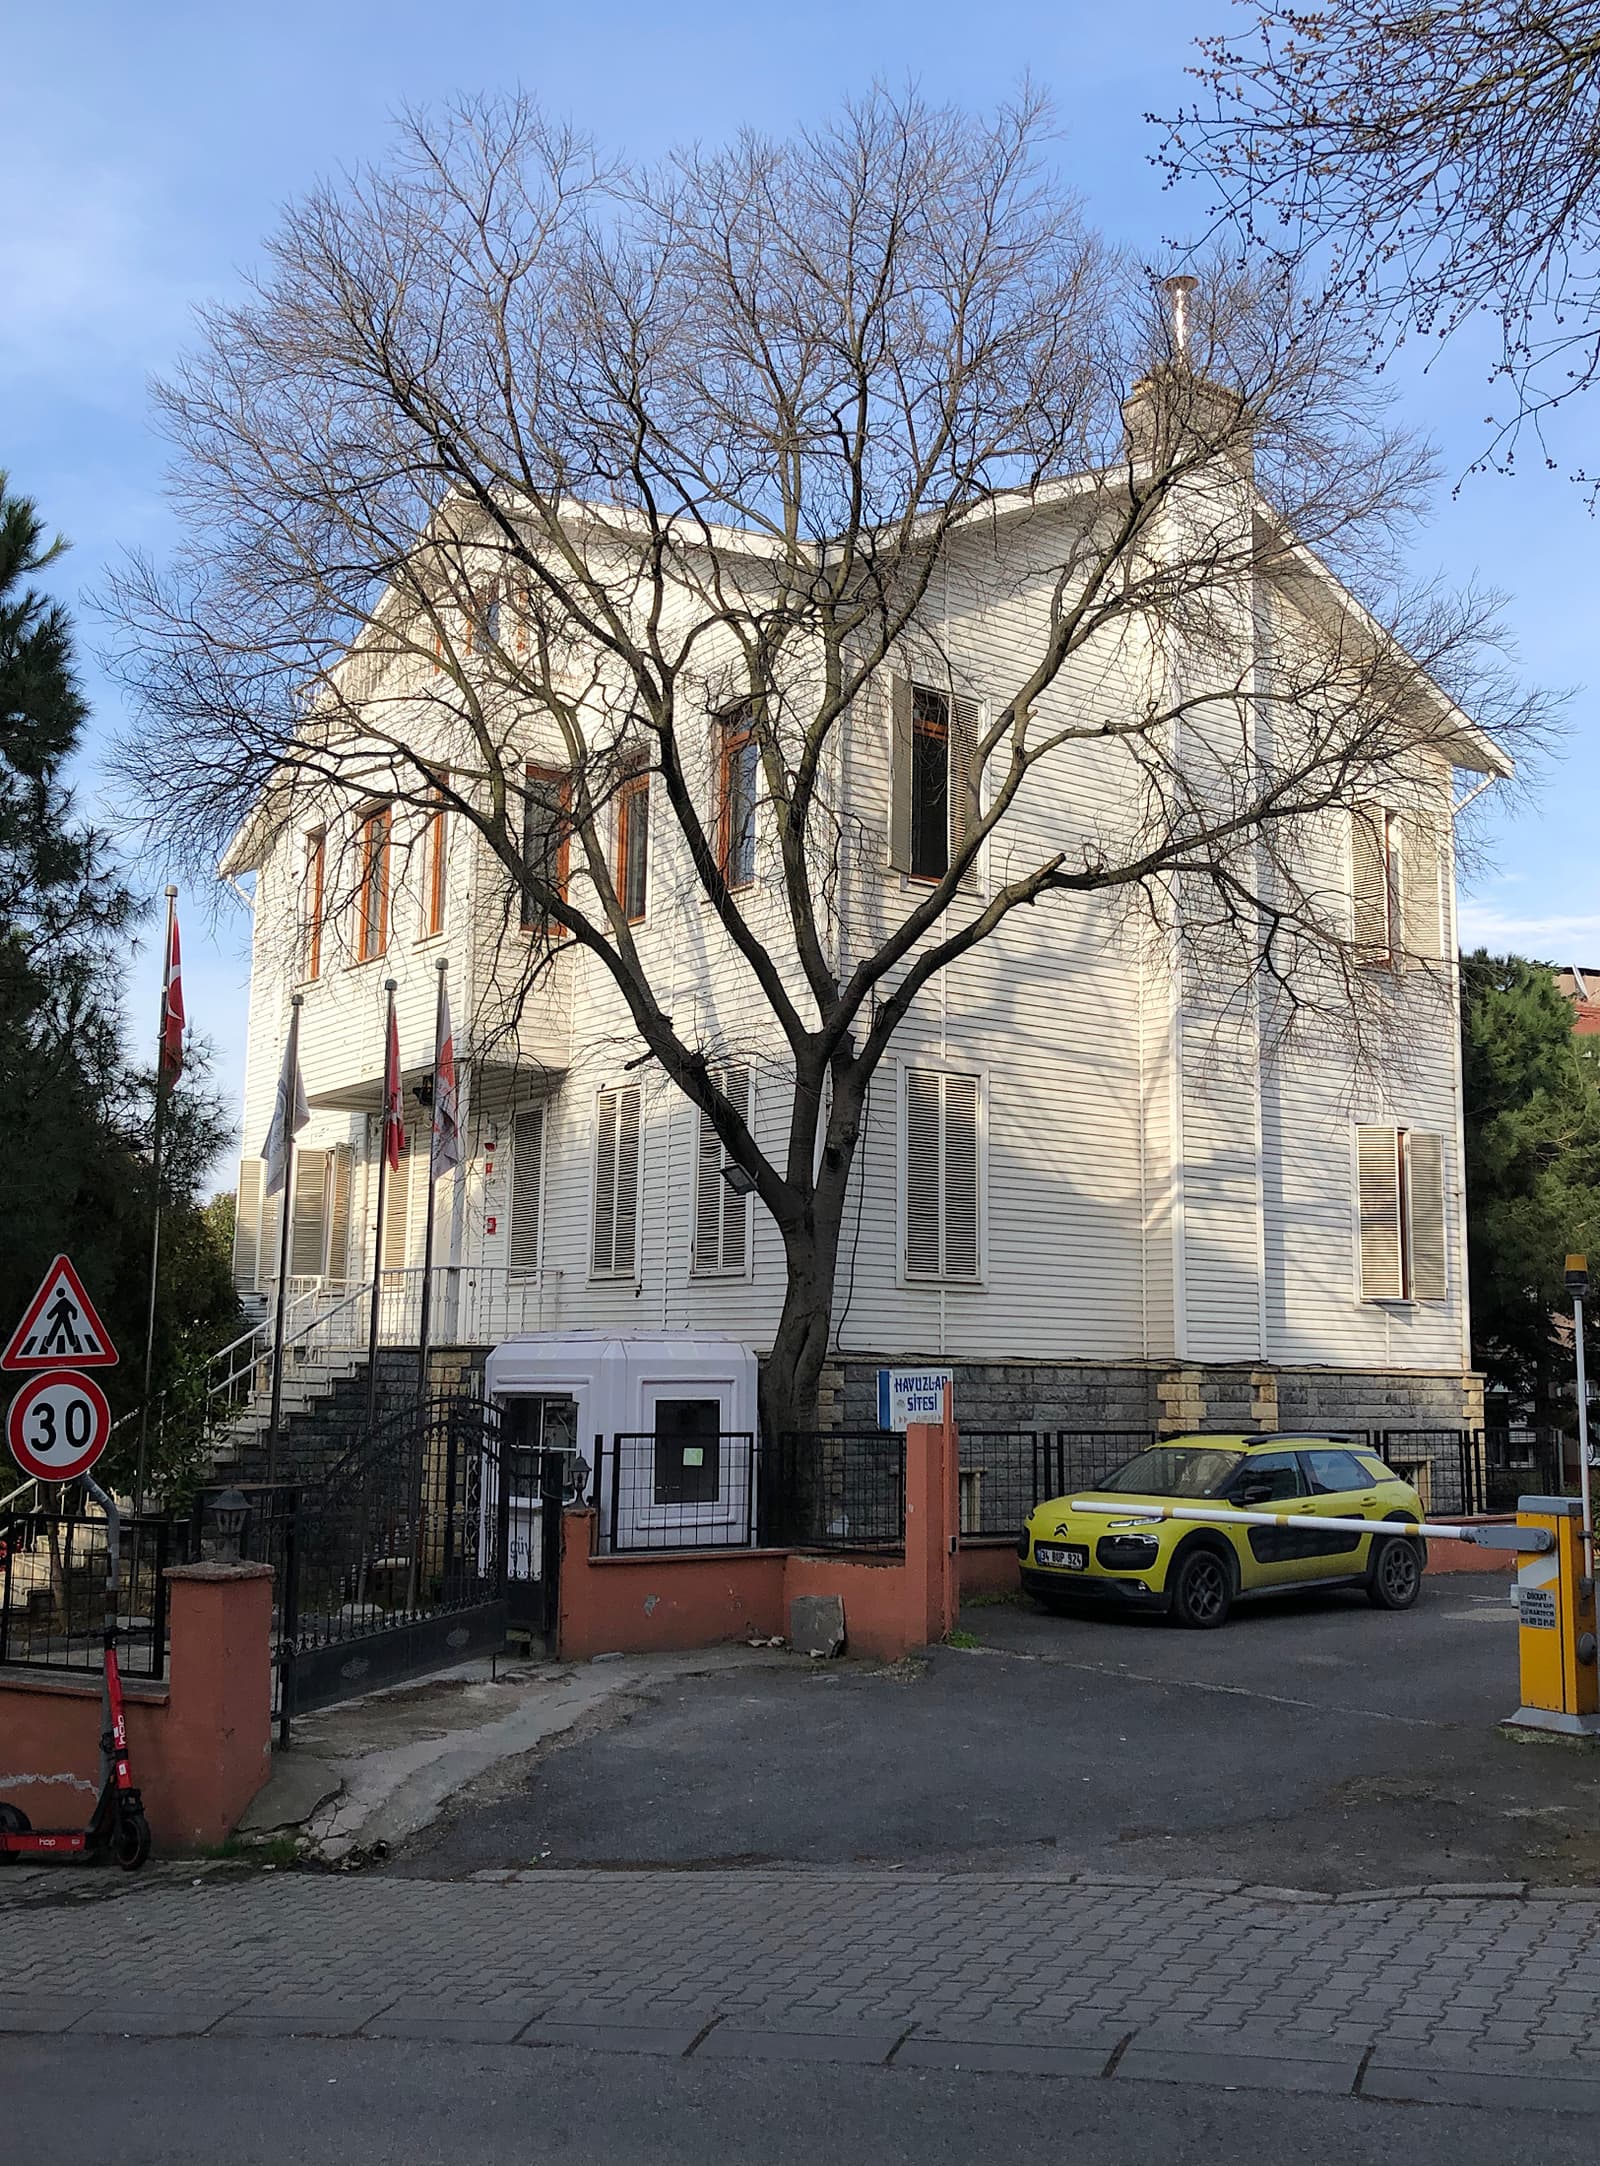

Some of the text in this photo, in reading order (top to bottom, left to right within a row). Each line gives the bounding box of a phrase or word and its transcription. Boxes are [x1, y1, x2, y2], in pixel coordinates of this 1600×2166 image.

[907, 1393, 937, 1411] SİTESİ
[31, 1400, 91, 1452] 30
[1041, 1550, 1050, 1561] 34
[118, 1715, 126, 1745] hop
[39, 1838, 56, 1847] hop
